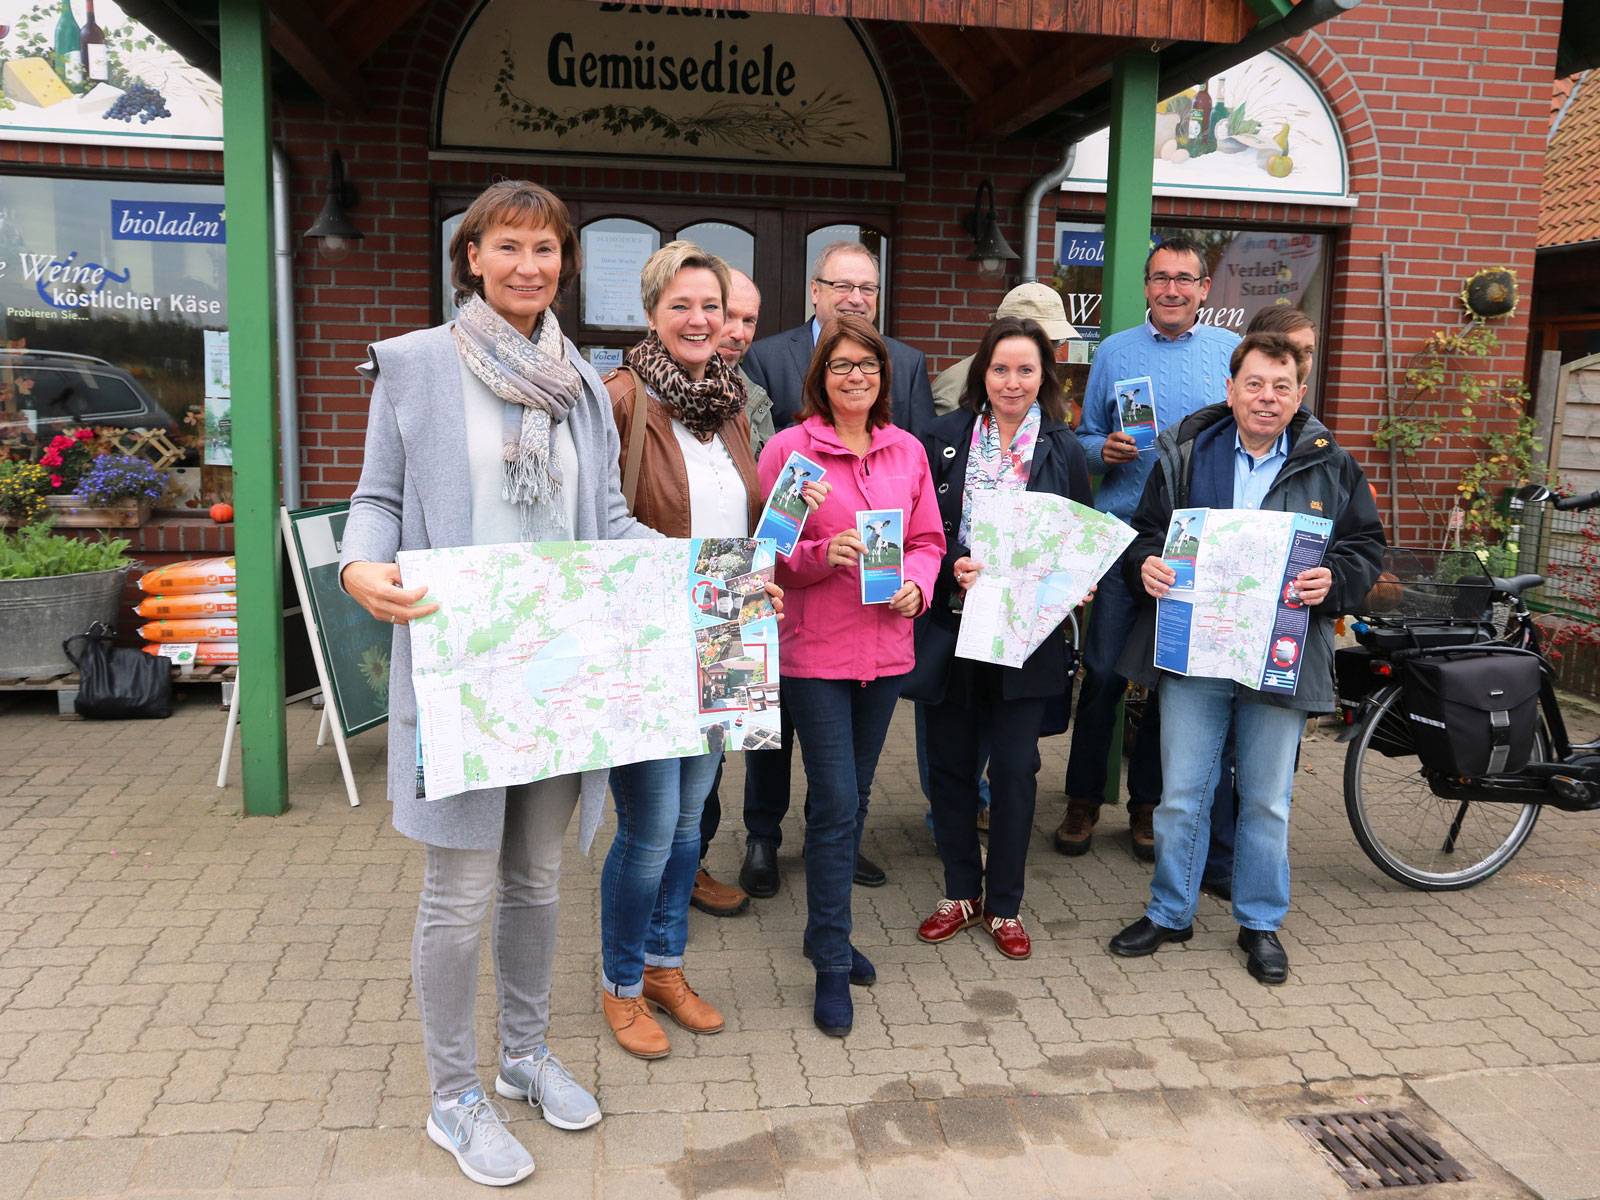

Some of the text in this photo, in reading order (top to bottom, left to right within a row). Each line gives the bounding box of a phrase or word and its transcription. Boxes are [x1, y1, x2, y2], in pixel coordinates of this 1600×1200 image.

[547, 32, 796, 97] Gemüsediele
[119, 210, 219, 237] bioladen
[19, 253, 105, 285] Weine
[7, 307, 89, 321] Probieren Sie...
[53, 288, 220, 314] köstlicher Käse
